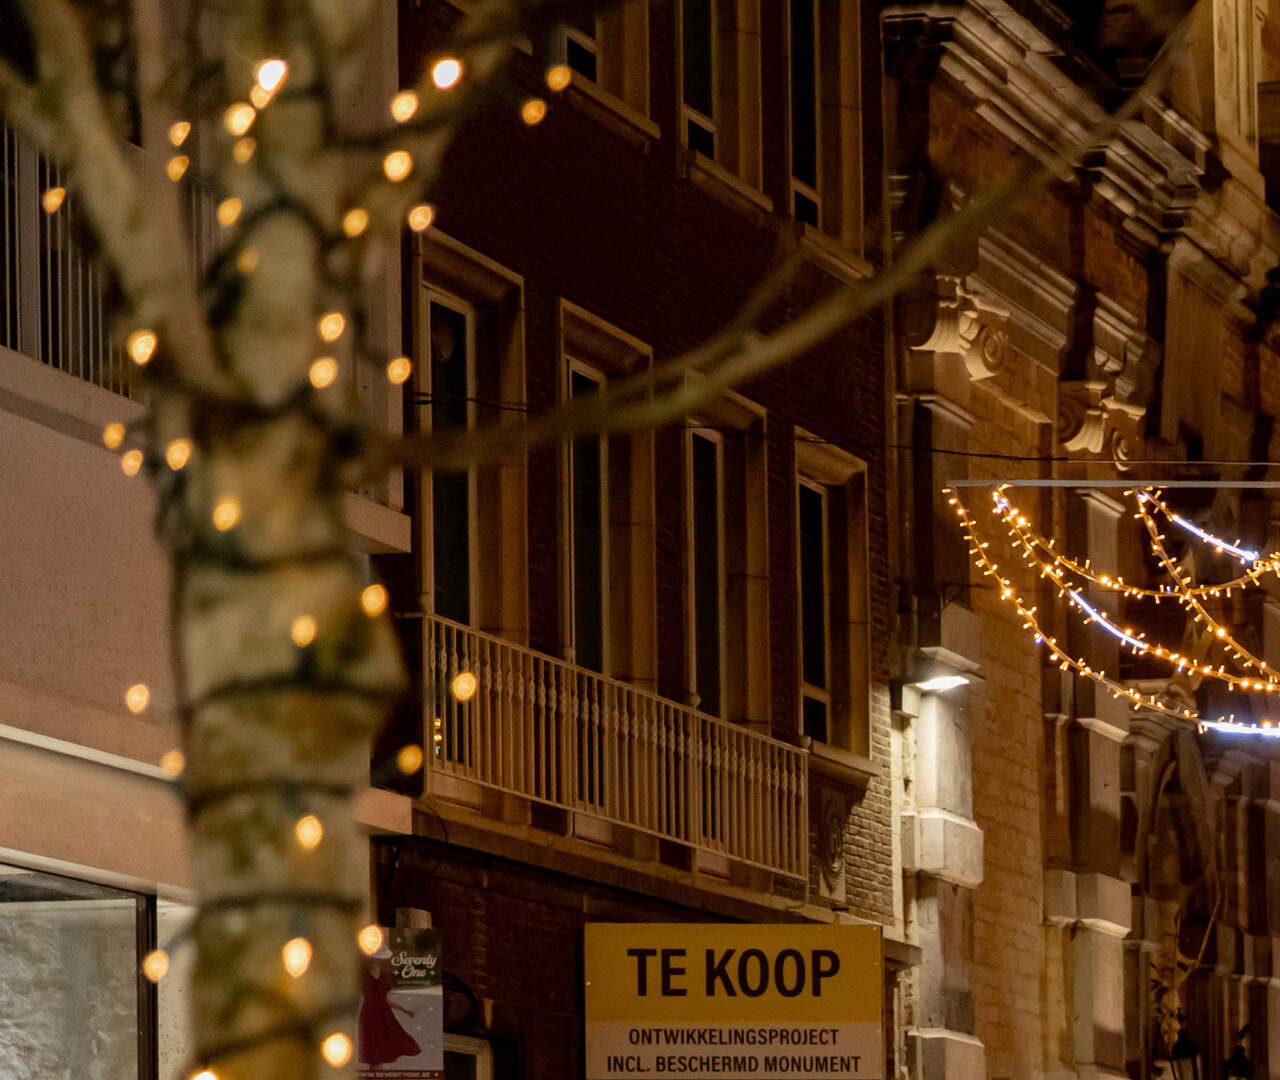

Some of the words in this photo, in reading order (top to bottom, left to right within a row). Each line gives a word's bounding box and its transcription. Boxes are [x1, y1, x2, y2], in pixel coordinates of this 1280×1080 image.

[390, 951, 438, 969] Seventy
[401, 965, 427, 979] One
[626, 948, 688, 998] TE
[705, 948, 842, 998] KOOP
[628, 1027, 839, 1047] ONTWIKKELINGSPROJECT
[606, 1055, 652, 1074] INCL.
[655, 1054, 760, 1074] BESCHERMD
[763, 1054, 861, 1074] MONUMENT
